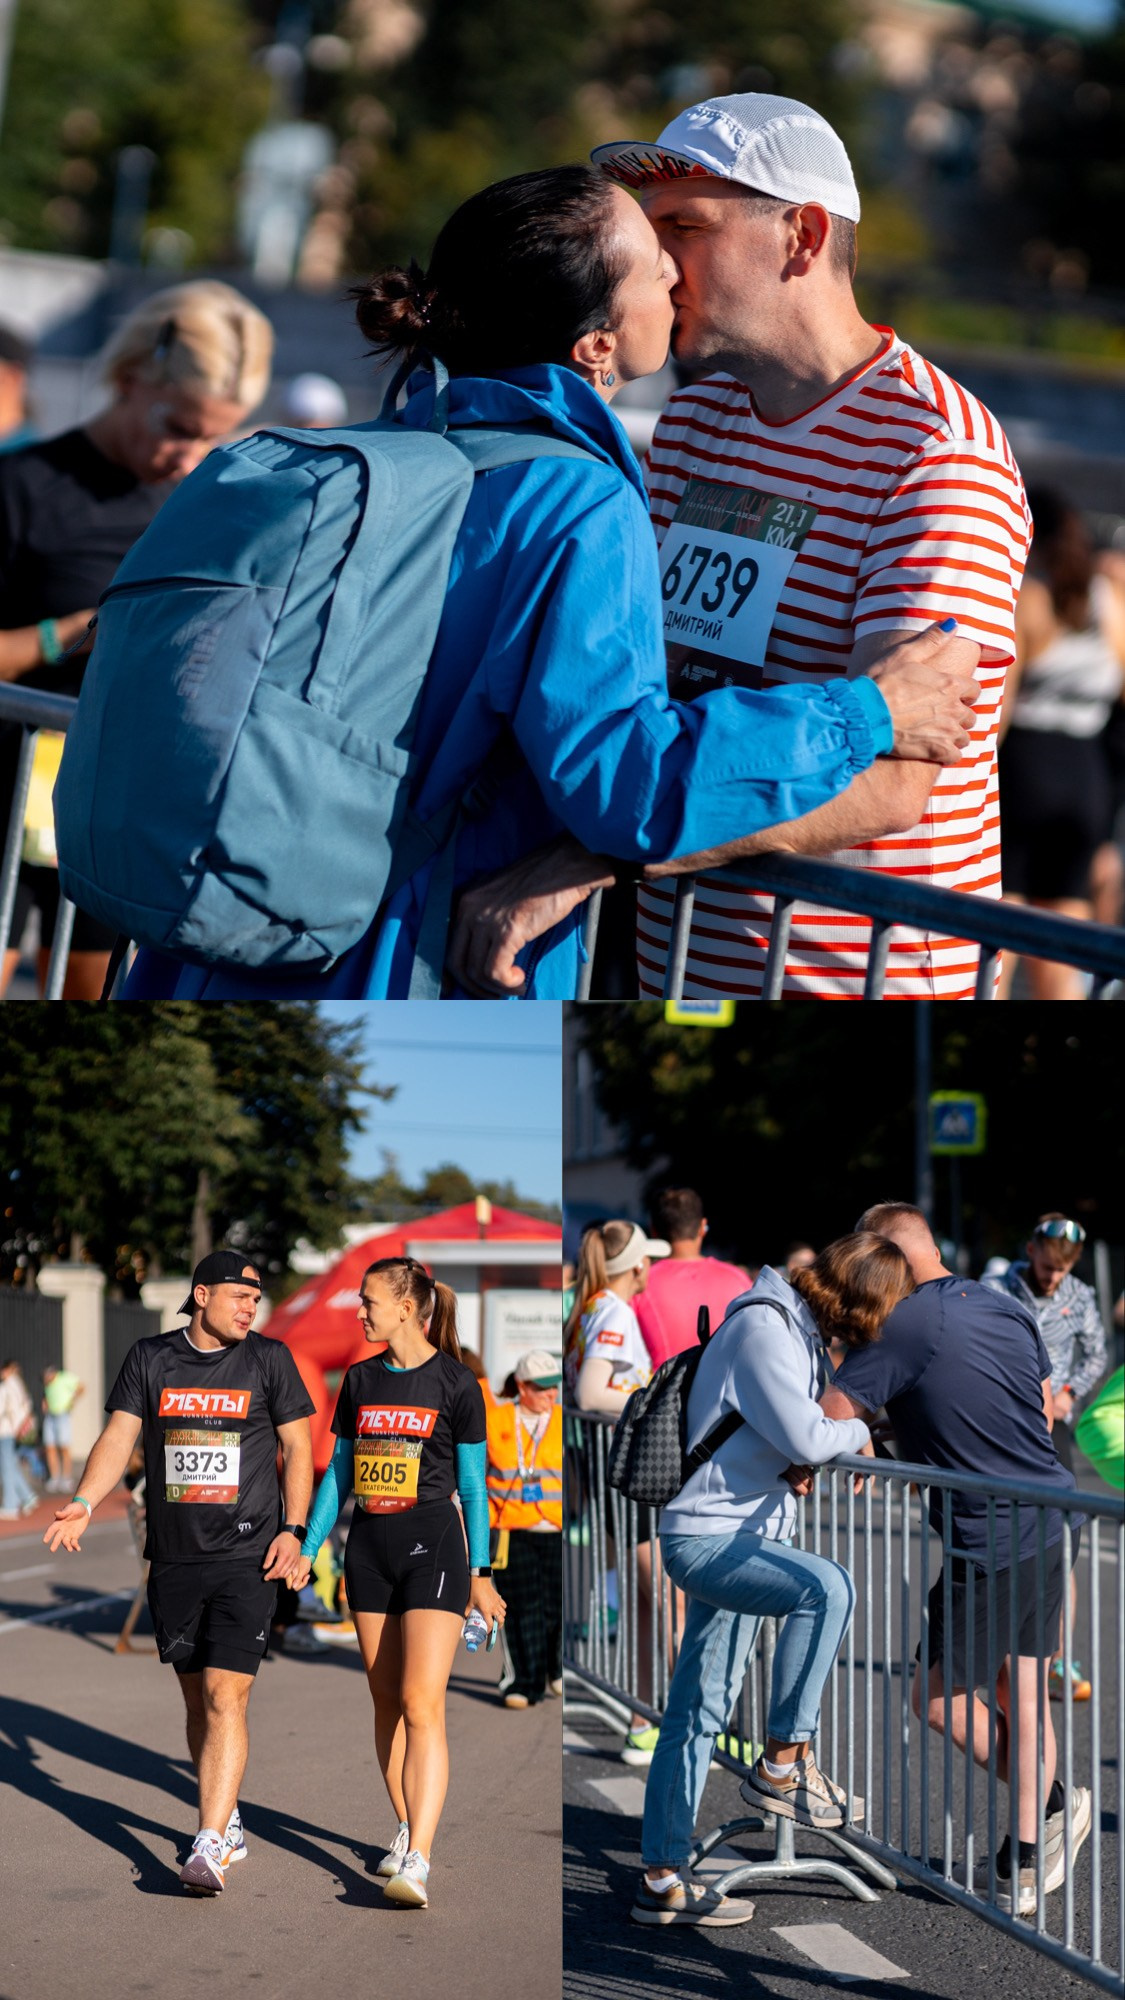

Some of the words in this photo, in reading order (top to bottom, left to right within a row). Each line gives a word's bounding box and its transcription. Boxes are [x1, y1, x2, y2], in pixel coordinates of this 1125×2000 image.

[772, 502, 808, 528] 21,1
[661, 543, 759, 618] 6739
[664, 610, 723, 640] ДМИТРИЙ
[163, 1393, 245, 1413] МЕЧТЫ
[359, 1410, 431, 1432] МЕЧТЫ
[174, 1451, 228, 1473] 3373
[360, 1461, 407, 1484] 2605
[182, 1473, 217, 1481] ДМИТРИЙ
[363, 1484, 399, 1493] ЕКАТЕРИНА
